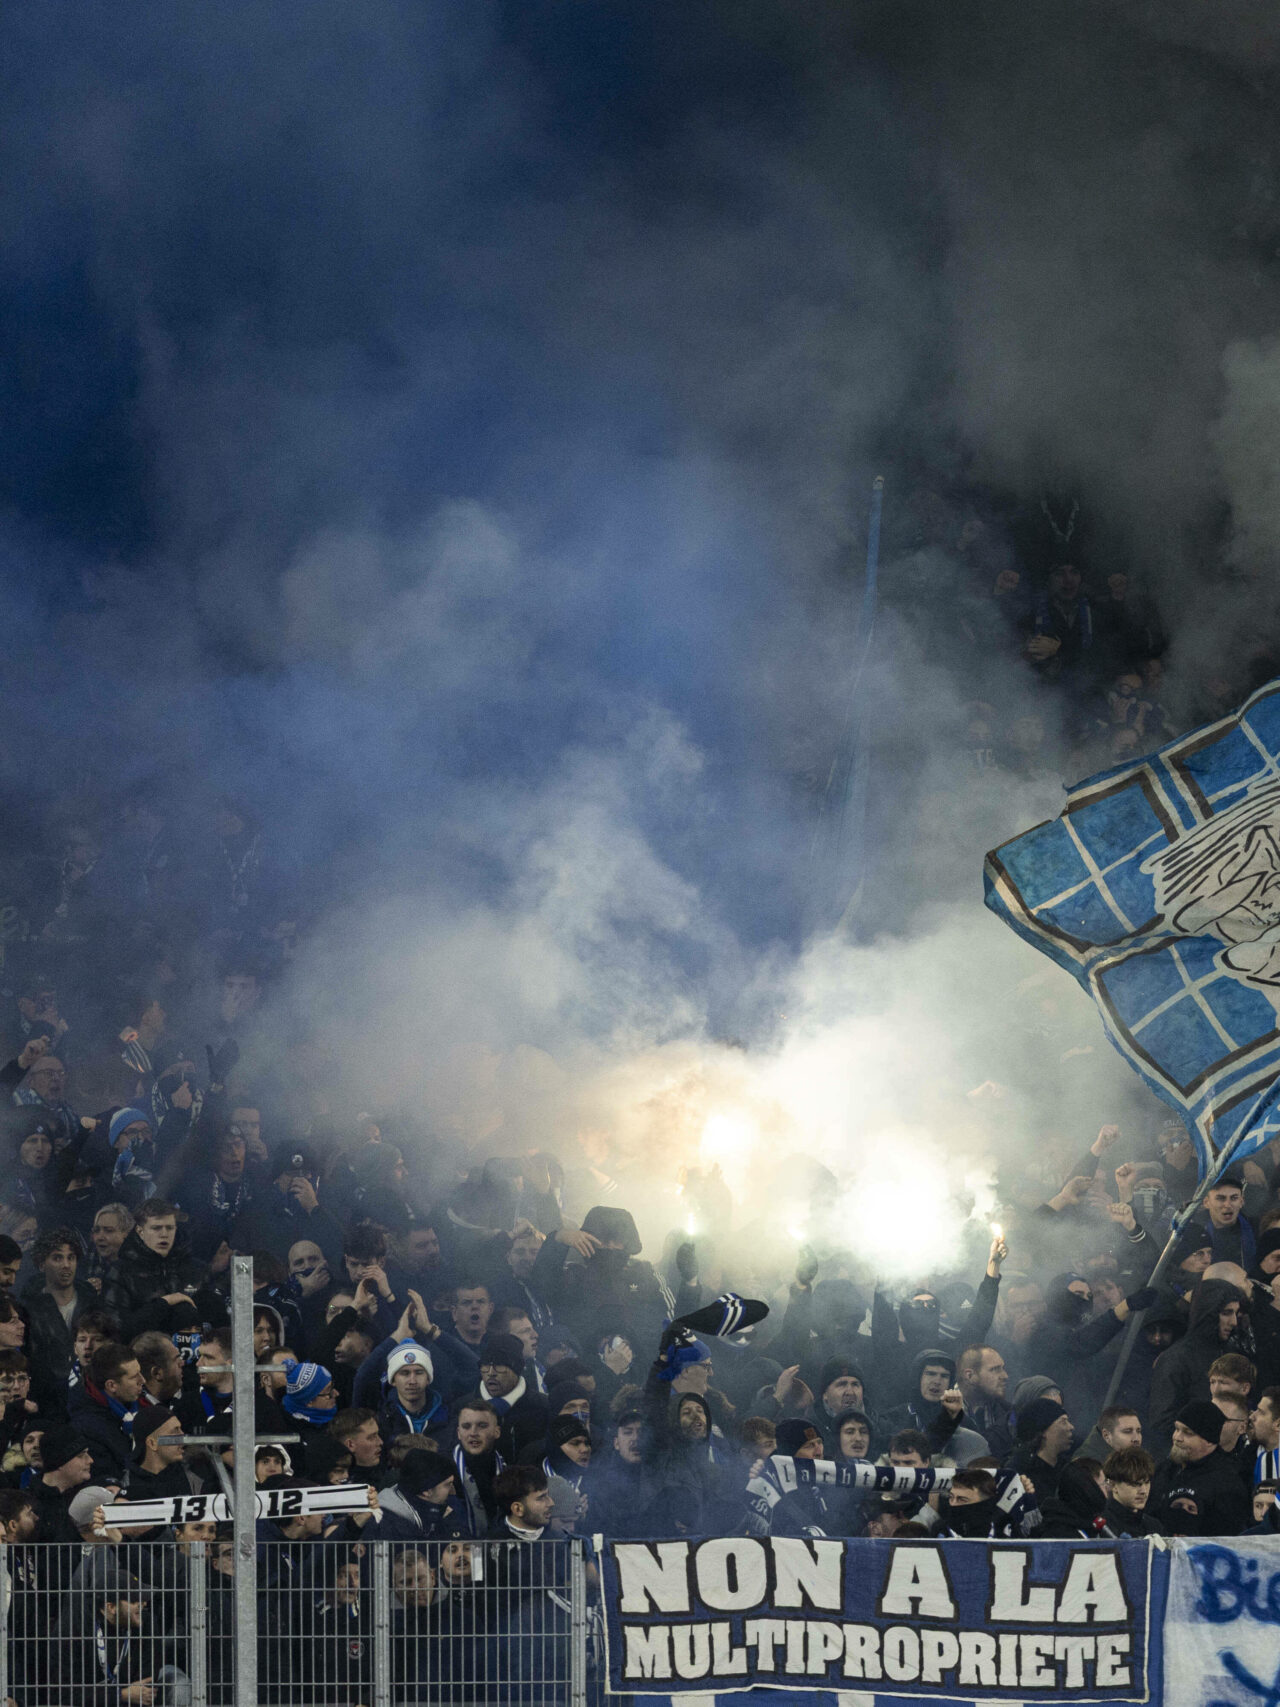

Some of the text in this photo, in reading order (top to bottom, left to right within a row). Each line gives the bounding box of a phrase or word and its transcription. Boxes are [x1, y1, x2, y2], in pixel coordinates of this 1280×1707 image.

[171, 1496, 207, 1524] 13
[266, 1490, 304, 1517] 12
[612, 1538, 1132, 1625] NON A LA
[622, 1617, 1133, 1690] MULTIPROPRIETE
